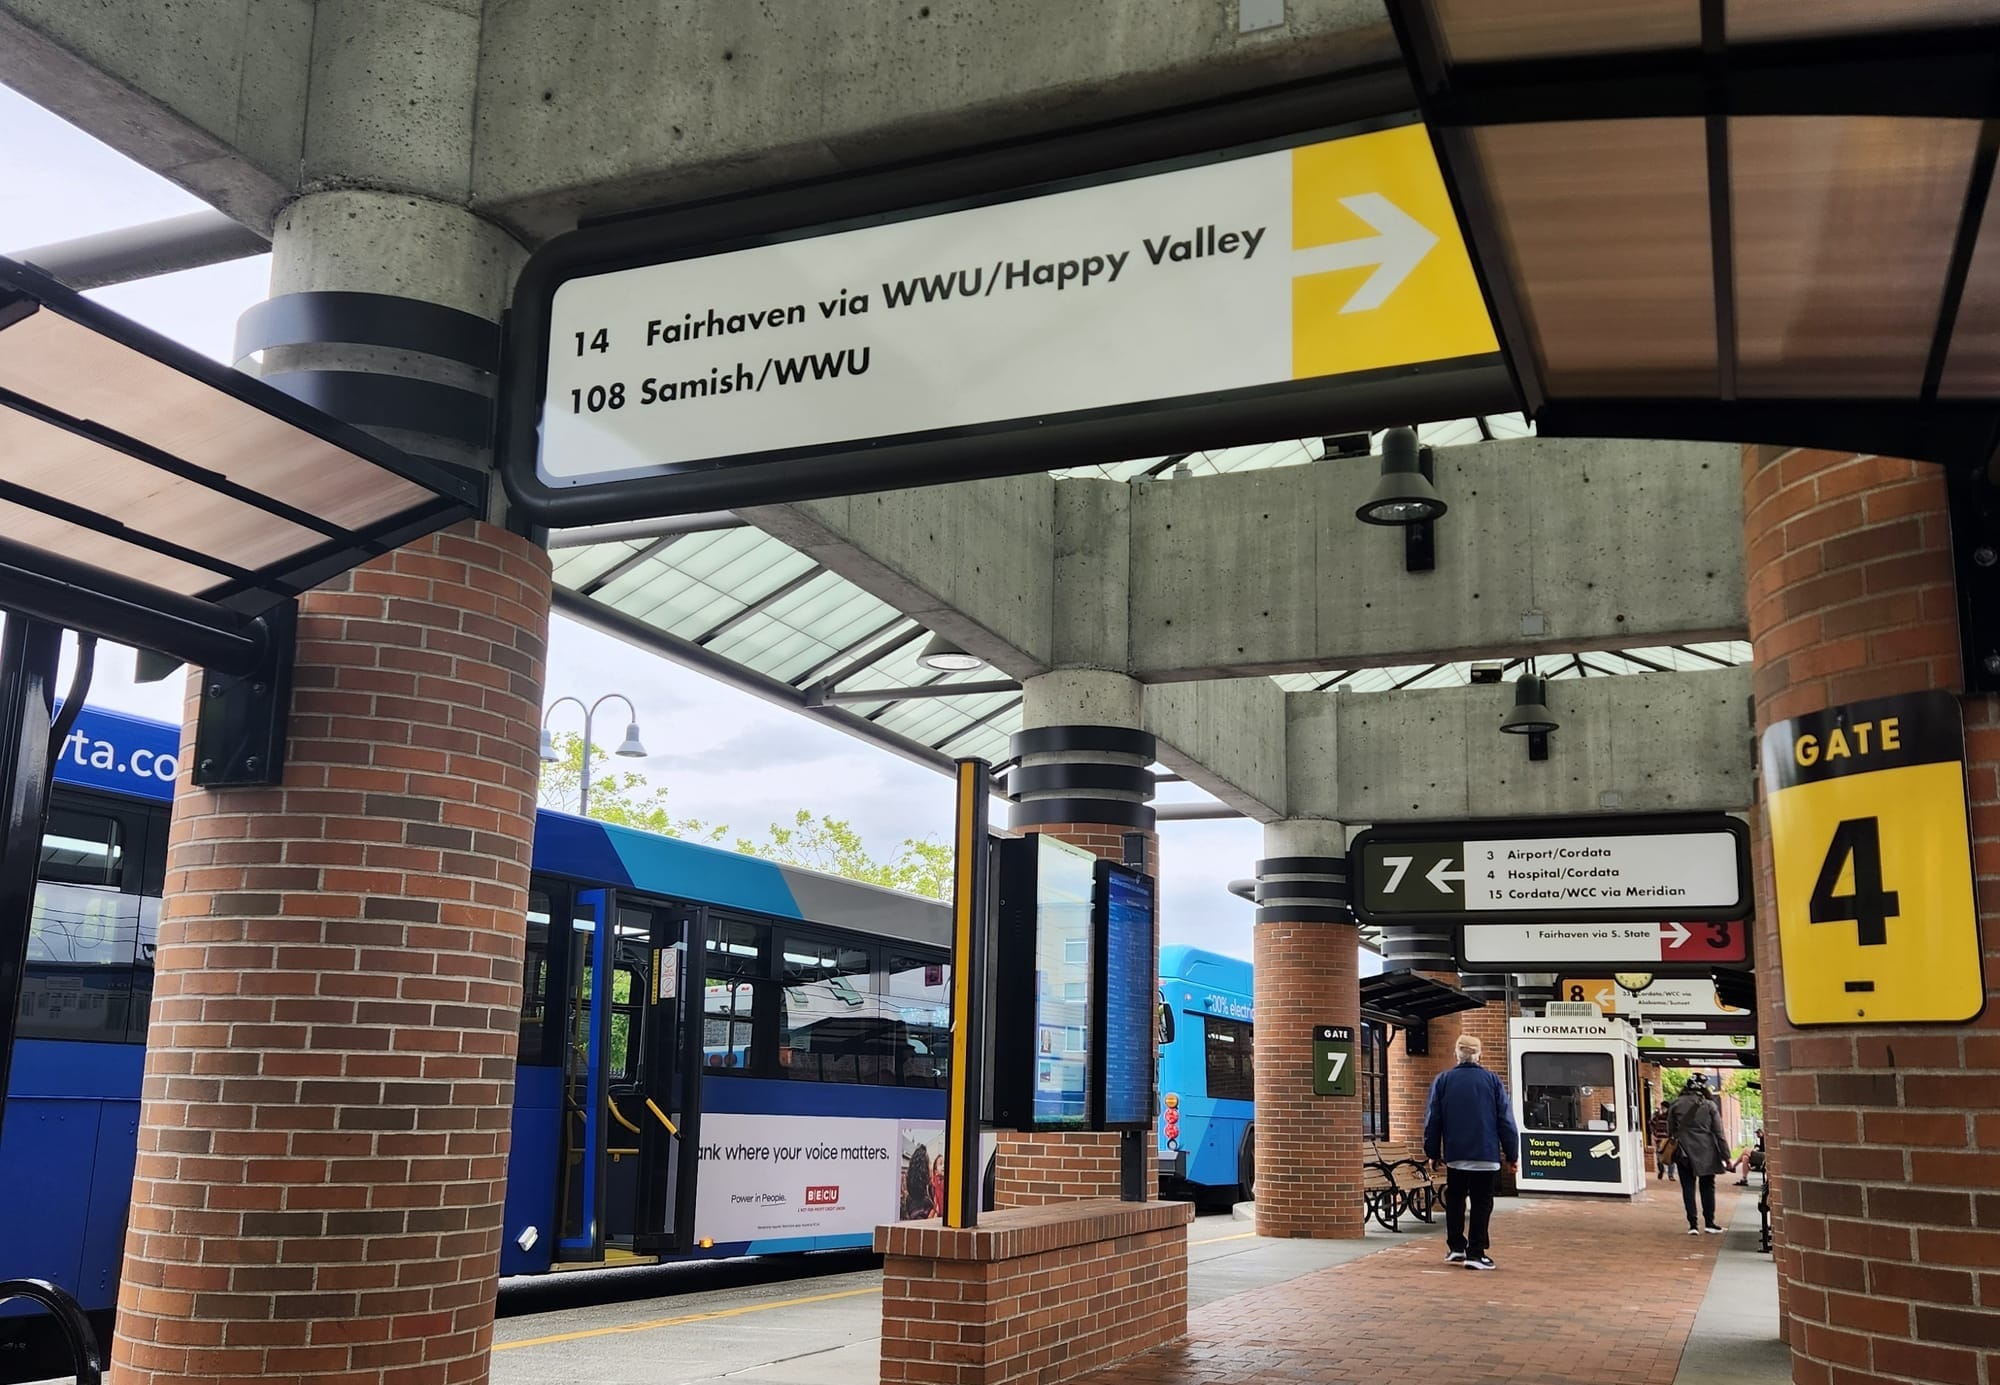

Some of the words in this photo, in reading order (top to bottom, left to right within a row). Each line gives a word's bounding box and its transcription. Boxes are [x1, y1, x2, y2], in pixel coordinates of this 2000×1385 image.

[575, 328, 609, 357] 14
[647, 304, 806, 347] Fairhaven
[819, 288, 869, 319] via
[881, 250, 1130, 309] WWU/Happy
[1143, 224, 1267, 266] Valley
[571, 382, 626, 414] 108
[640, 346, 871, 405] Samish/WWU
[1795, 717, 1901, 767] GATE
[57, 729, 179, 782] ta.co
[1487, 850, 1494, 860] 3
[1507, 847, 1611, 861] Airport/Cordata
[1382, 856, 1413, 894] 7
[1487, 870, 1495, 879] 4
[1508, 866, 1620, 881] Hospital/Cordata
[1809, 816, 1900, 946] 4
[1489, 889, 1502, 899] 15
[1508, 887, 1597, 900] Cordata/WCC
[1601, 886, 1621, 897] via
[1626, 885, 1686, 896] Meridian
[1525, 930, 1530, 939] 1
[1539, 929, 1589, 939] Fairhaven
[1592, 929, 1608, 938] via
[1611, 929, 1620, 938] S.
[1624, 929, 1650, 938] State
[1706, 921, 1731, 949] 3
[1570, 984, 1584, 1002] 8
[1324, 1029, 1348, 1039] GATE
[1523, 1025, 1606, 1034] INFORMATION
[1327, 1052, 1347, 1082] 7
[1529, 1138, 1545, 1146] You
[725, 1144, 769, 1160] where
[773, 1146, 802, 1163] your
[805, 1142, 837, 1160] voice
[840, 1145, 889, 1160] matters.
[1549, 1148, 1572, 1159] being
[1530, 1158, 1566, 1167] recorded
[731, 1194, 753, 1203] Power
[755, 1193, 761, 1202] in
[762, 1193, 786, 1203] People.
[808, 1190, 837, 1201] BECU
